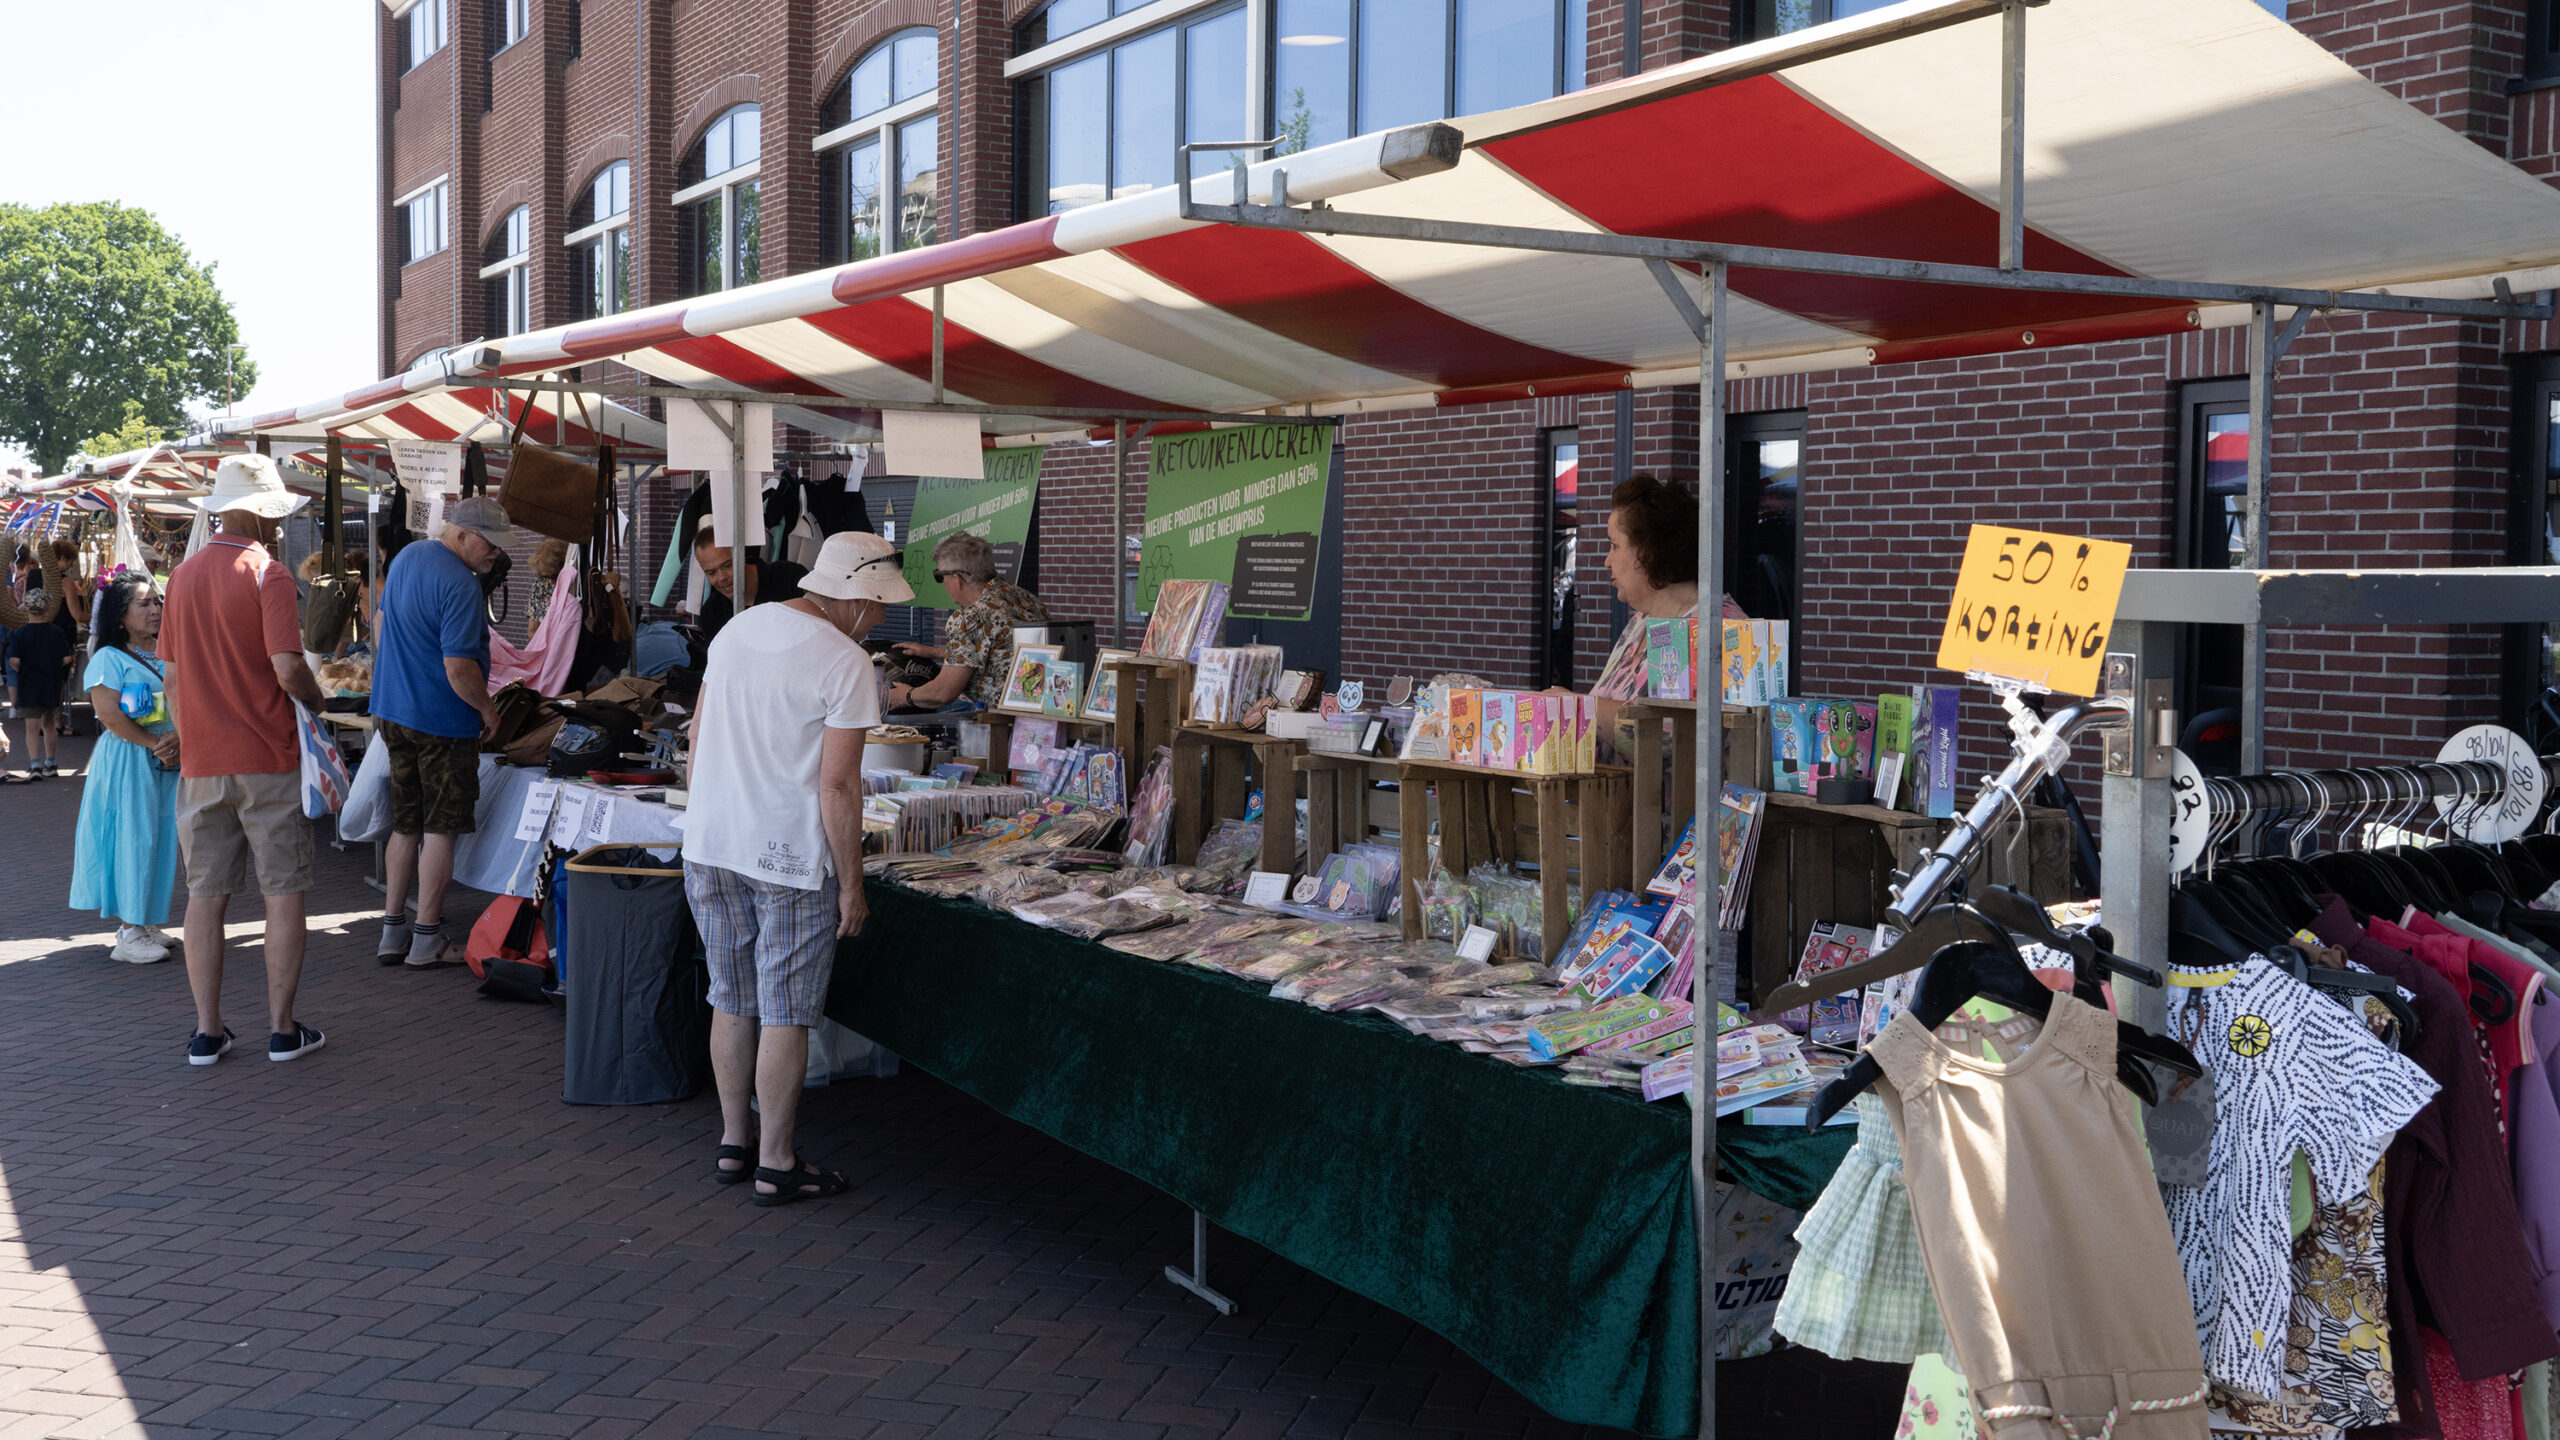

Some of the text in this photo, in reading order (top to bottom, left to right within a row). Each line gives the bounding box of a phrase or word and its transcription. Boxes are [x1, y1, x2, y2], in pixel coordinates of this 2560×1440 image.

[929, 514, 961, 538] PRODUCTEN
[961, 506, 977, 525] VOOR
[977, 496, 1001, 519] MINDER
[1001, 490, 1014, 511] DAN
[1014, 485, 1030, 506] 50%
[1145, 462, 1319, 540] NIEUWE PRODUCTEN VOOR MINDER DAN 50%
[1188, 505, 1265, 548] VAN DE NIEUWPRIJS
[1992, 537, 2092, 592] 50 %
[1938, 727, 1951, 791] Diamond Light
[2465, 729, 2505, 759] 98/104
[757, 858, 810, 877] No. 327/50
[2150, 1116, 2205, 1138] QUAPI
[1715, 1273, 1789, 1310] CTIO
